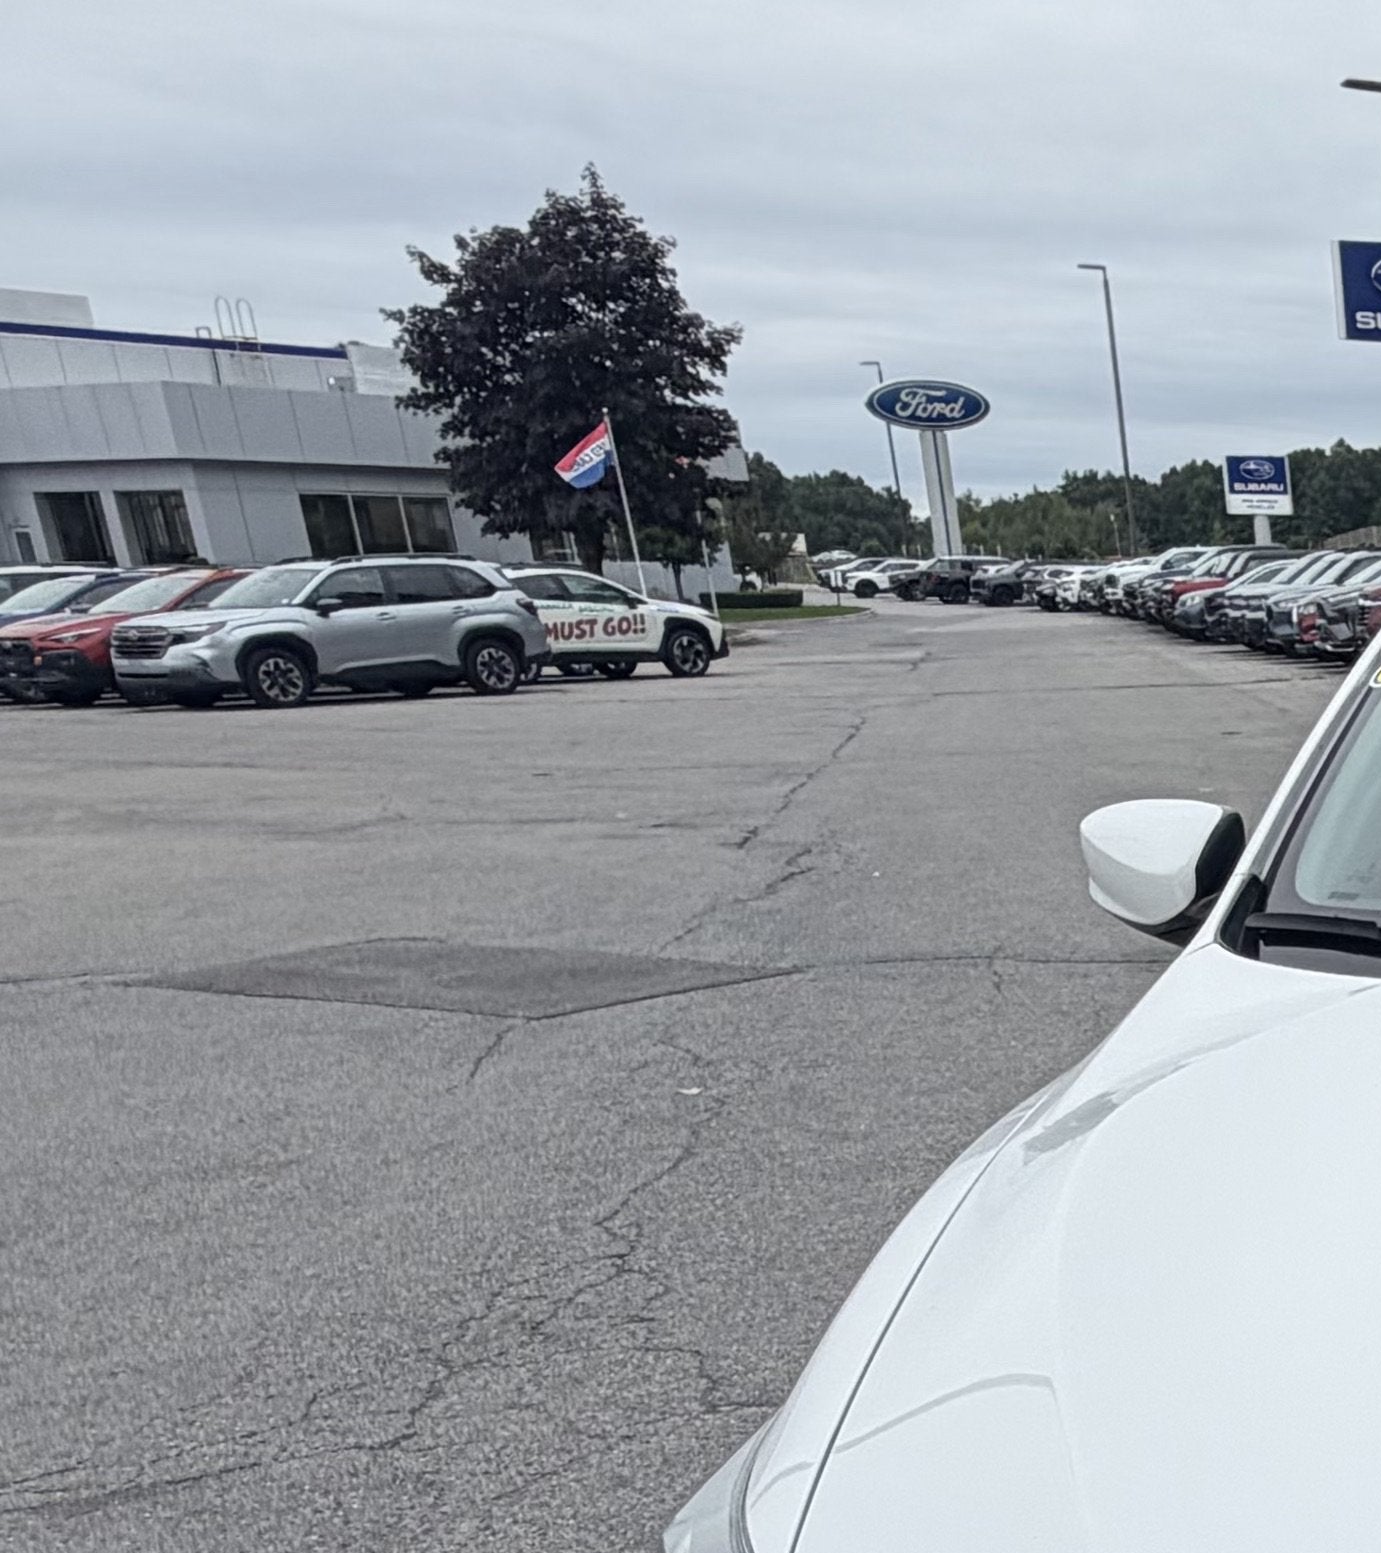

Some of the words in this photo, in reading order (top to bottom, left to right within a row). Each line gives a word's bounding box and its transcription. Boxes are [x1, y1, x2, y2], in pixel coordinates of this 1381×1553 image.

[895, 387, 966, 419] Ford
[1233, 482, 1284, 492] SUBARU
[543, 618, 598, 641] MUST
[602, 613, 646, 637] GO!!
